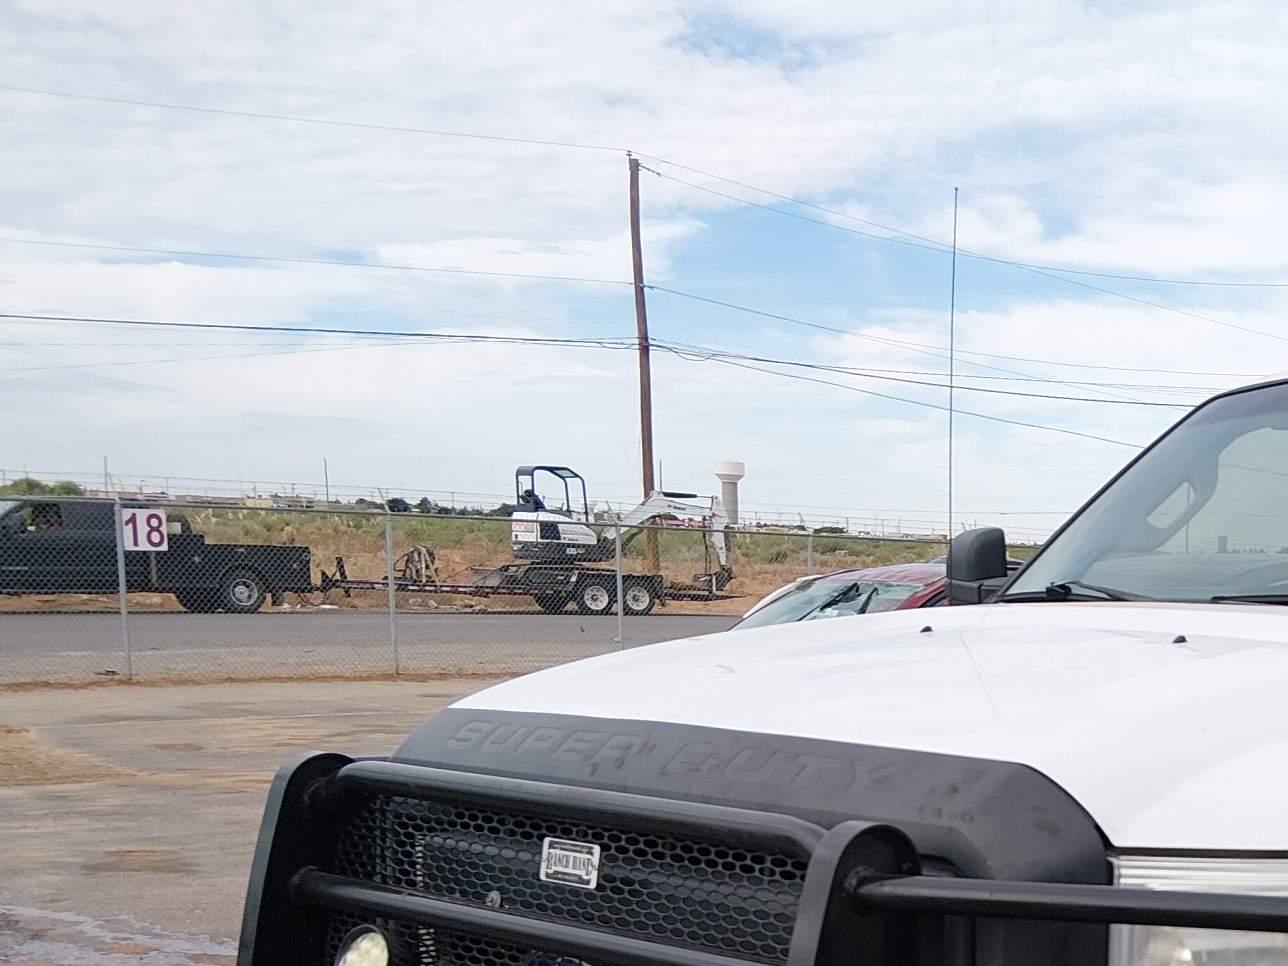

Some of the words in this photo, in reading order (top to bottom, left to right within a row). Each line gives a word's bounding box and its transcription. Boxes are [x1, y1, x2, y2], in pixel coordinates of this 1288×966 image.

[124, 512, 165, 548] 18
[448, 720, 646, 765] SUPER
[658, 741, 898, 793] DUTY
